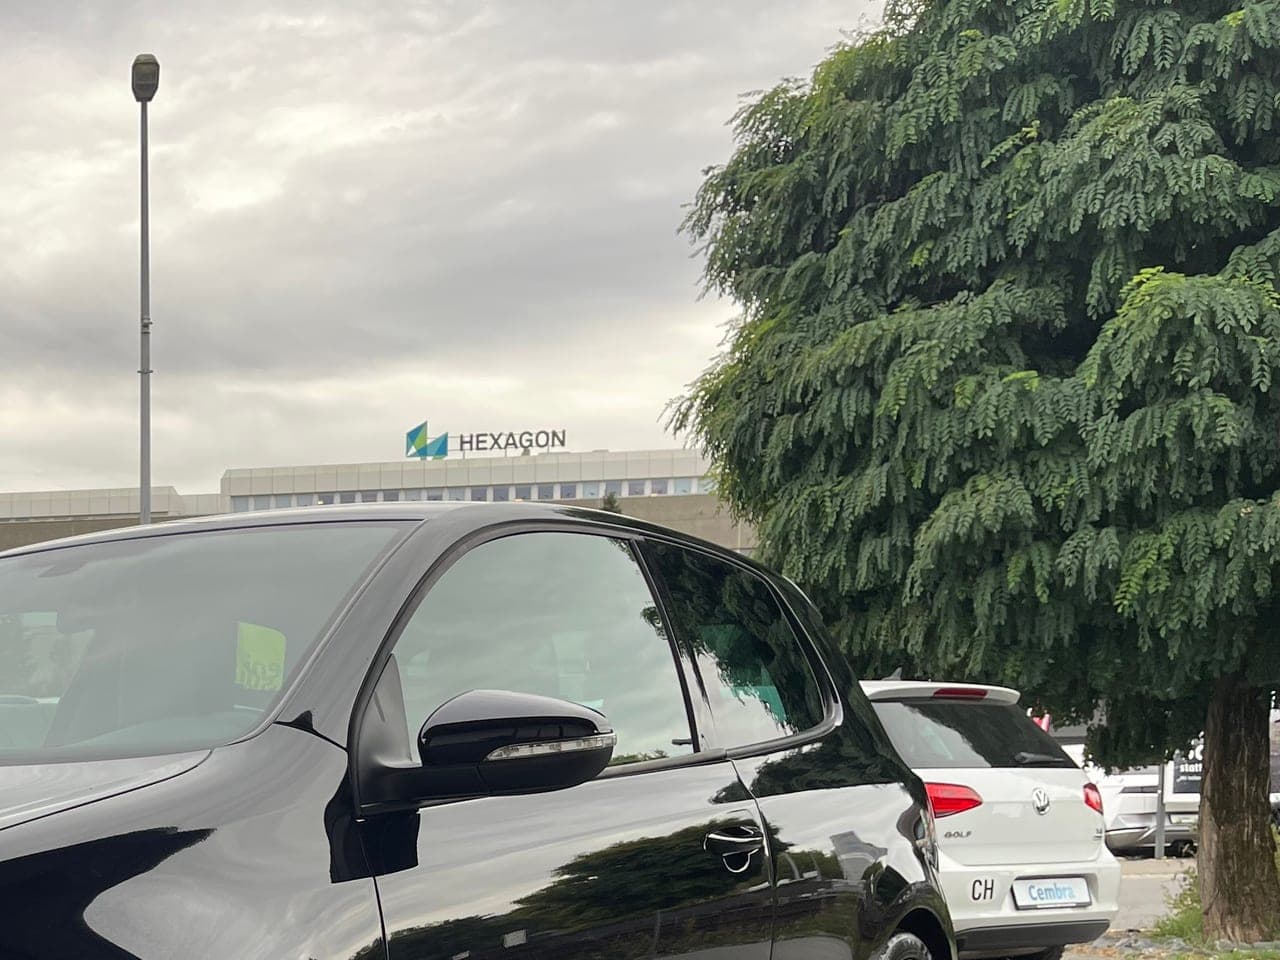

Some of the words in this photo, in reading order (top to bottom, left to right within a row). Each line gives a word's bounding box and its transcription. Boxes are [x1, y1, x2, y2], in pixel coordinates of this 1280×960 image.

[459, 429, 566, 452] HEXAGON
[944, 830, 972, 839] GOLF
[971, 879, 995, 901] CH
[1028, 882, 1075, 901] Cembra
